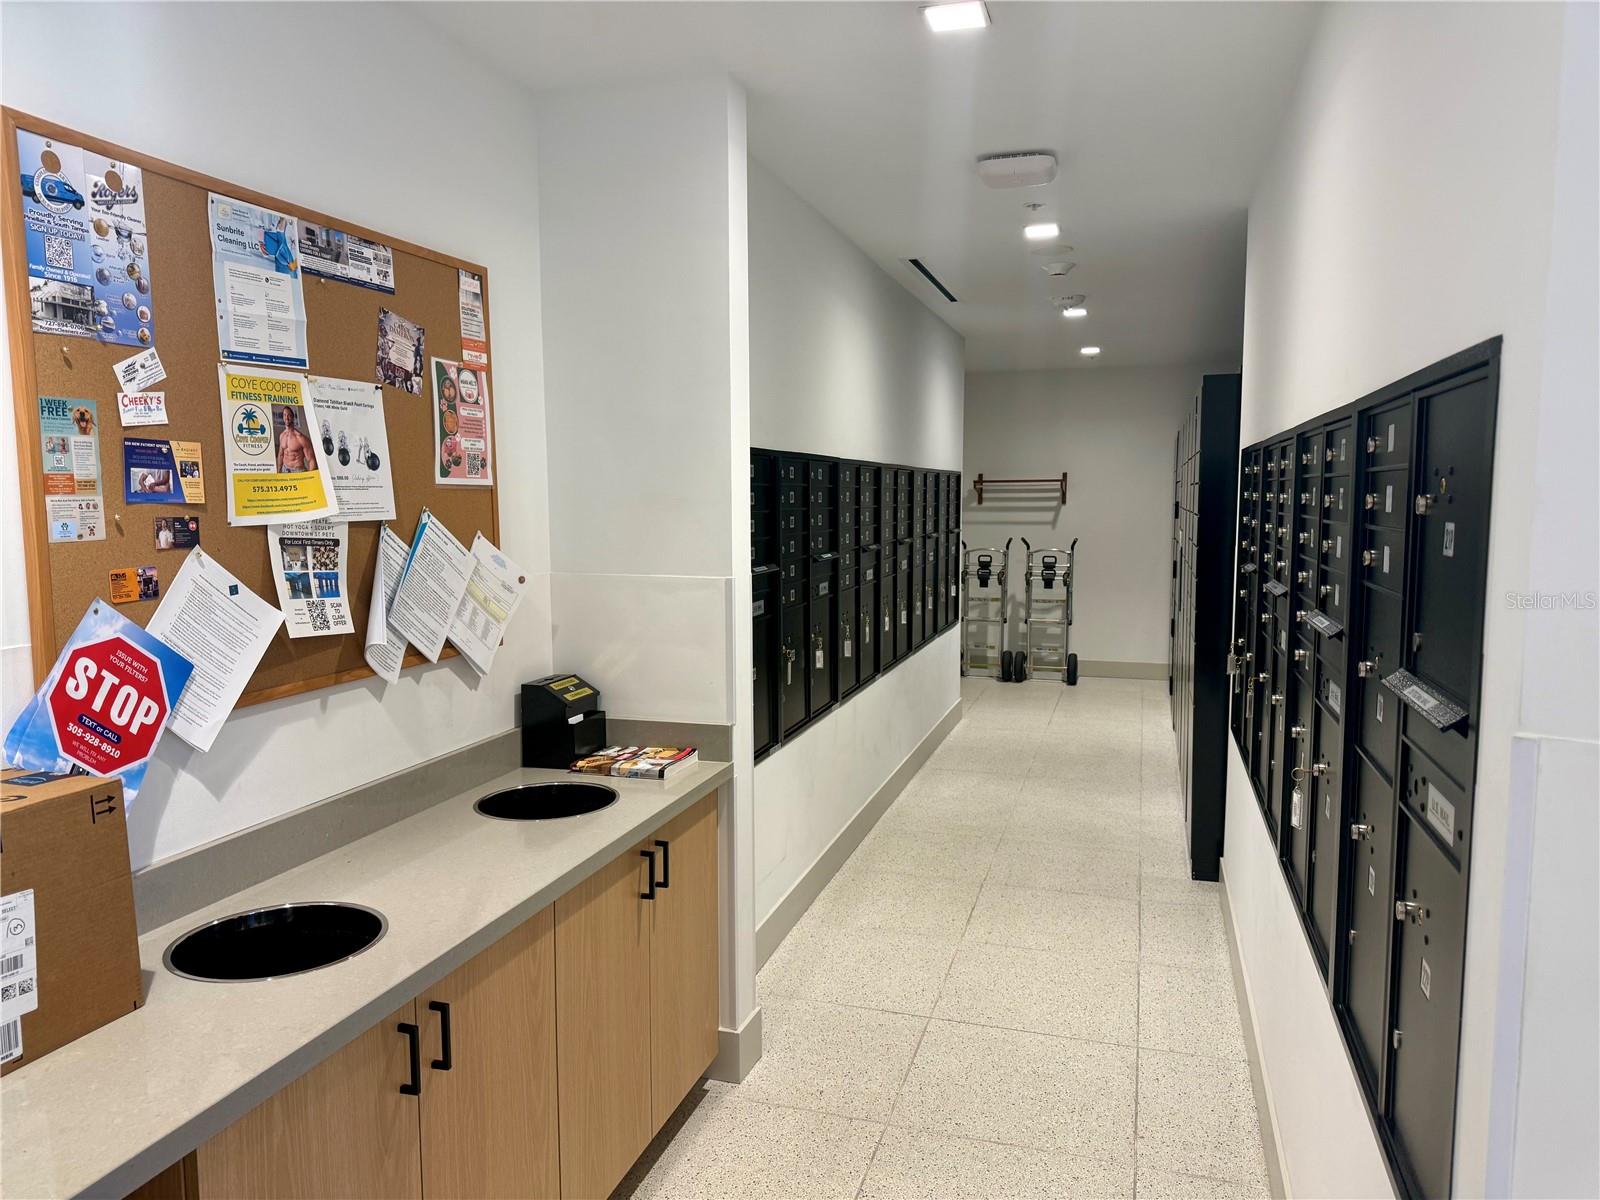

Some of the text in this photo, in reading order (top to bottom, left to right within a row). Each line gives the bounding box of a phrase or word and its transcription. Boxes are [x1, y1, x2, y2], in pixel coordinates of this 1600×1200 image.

[30, 223, 47, 233] SIGN
[48, 227, 58, 235] UP
[60, 229, 85, 241] TODAY!
[216, 222, 245, 236] Sunbrite
[217, 234, 260, 251] Cleaning LLC
[231, 377, 297, 393] COYE COOPER
[39, 398, 68, 407] 1 WEEK
[121, 394, 162, 407] CHEEKY'S
[231, 391, 299, 404] FITNESS TRAINING
[40, 406, 68, 417] FREE
[252, 484, 298, 493] 575.313.4975
[109, 655, 149, 682] YOUR FILTERS?
[116, 649, 148, 673] ISSUE WITH
[65, 656, 160, 736] STOP
[81, 715, 97, 729] TEXT
[103, 729, 118, 743] CALL
[66, 722, 121, 758] 305-928-8910
